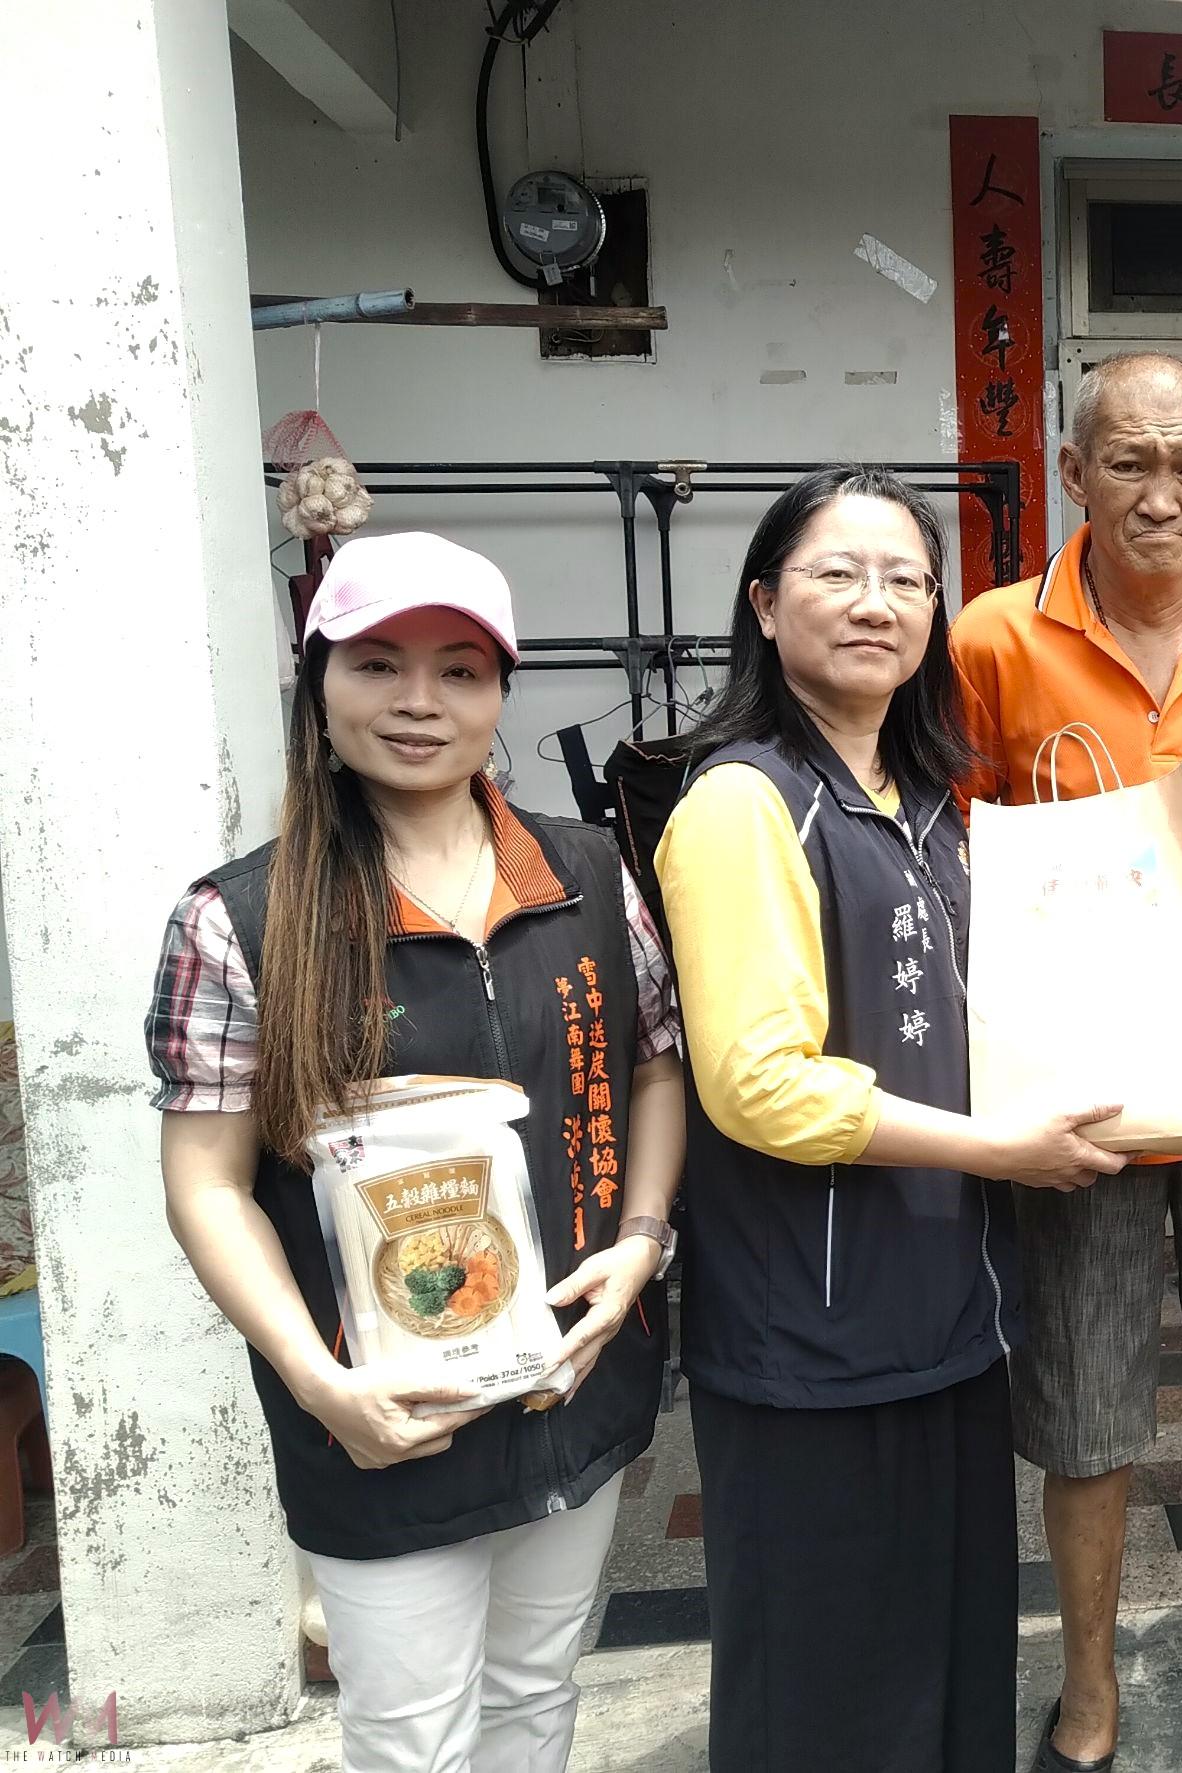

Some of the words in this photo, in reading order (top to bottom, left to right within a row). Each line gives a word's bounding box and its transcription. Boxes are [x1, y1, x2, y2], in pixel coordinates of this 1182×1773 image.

[891, 903, 931, 1046] 羅婷婷
[554, 976, 585, 1096] 夢江南舞團
[577, 956, 619, 1209] 雪中送炭關懷協會
[384, 1176, 479, 1214] 五穀雜糧麵
[405, 1211, 431, 1223] CEREAL
[432, 1205, 464, 1217] NOODLE
